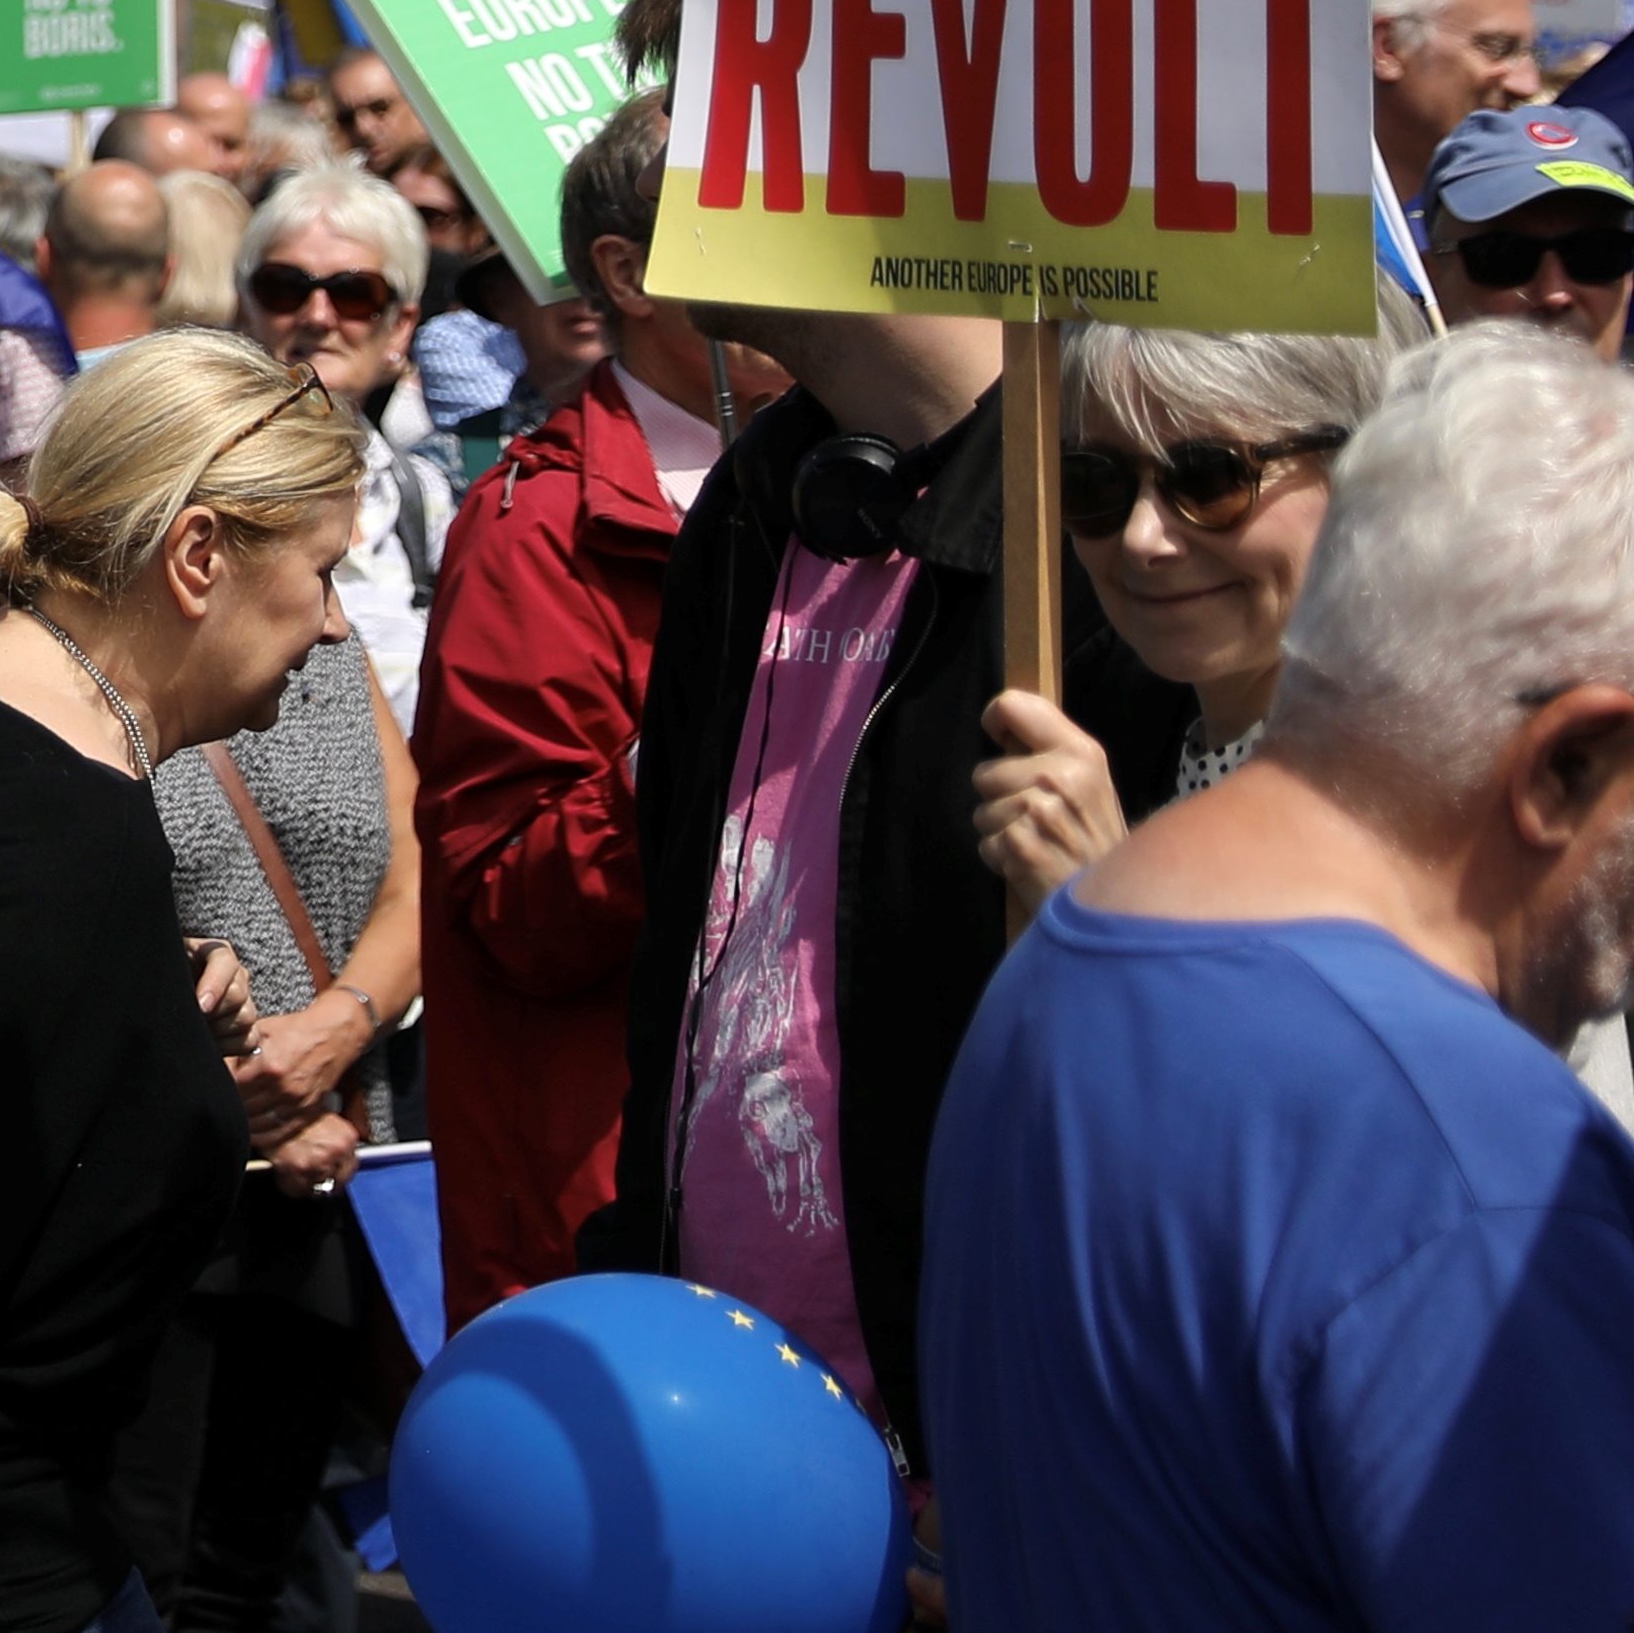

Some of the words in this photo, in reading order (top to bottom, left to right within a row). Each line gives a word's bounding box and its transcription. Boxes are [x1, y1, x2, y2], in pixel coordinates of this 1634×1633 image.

[504, 51, 595, 121] NO
[870, 256, 963, 293] ANOTHER
[967, 261, 1033, 297] EUROPE
[1038, 266, 1060, 297] IS
[1063, 266, 1159, 303] POSSIBLE
